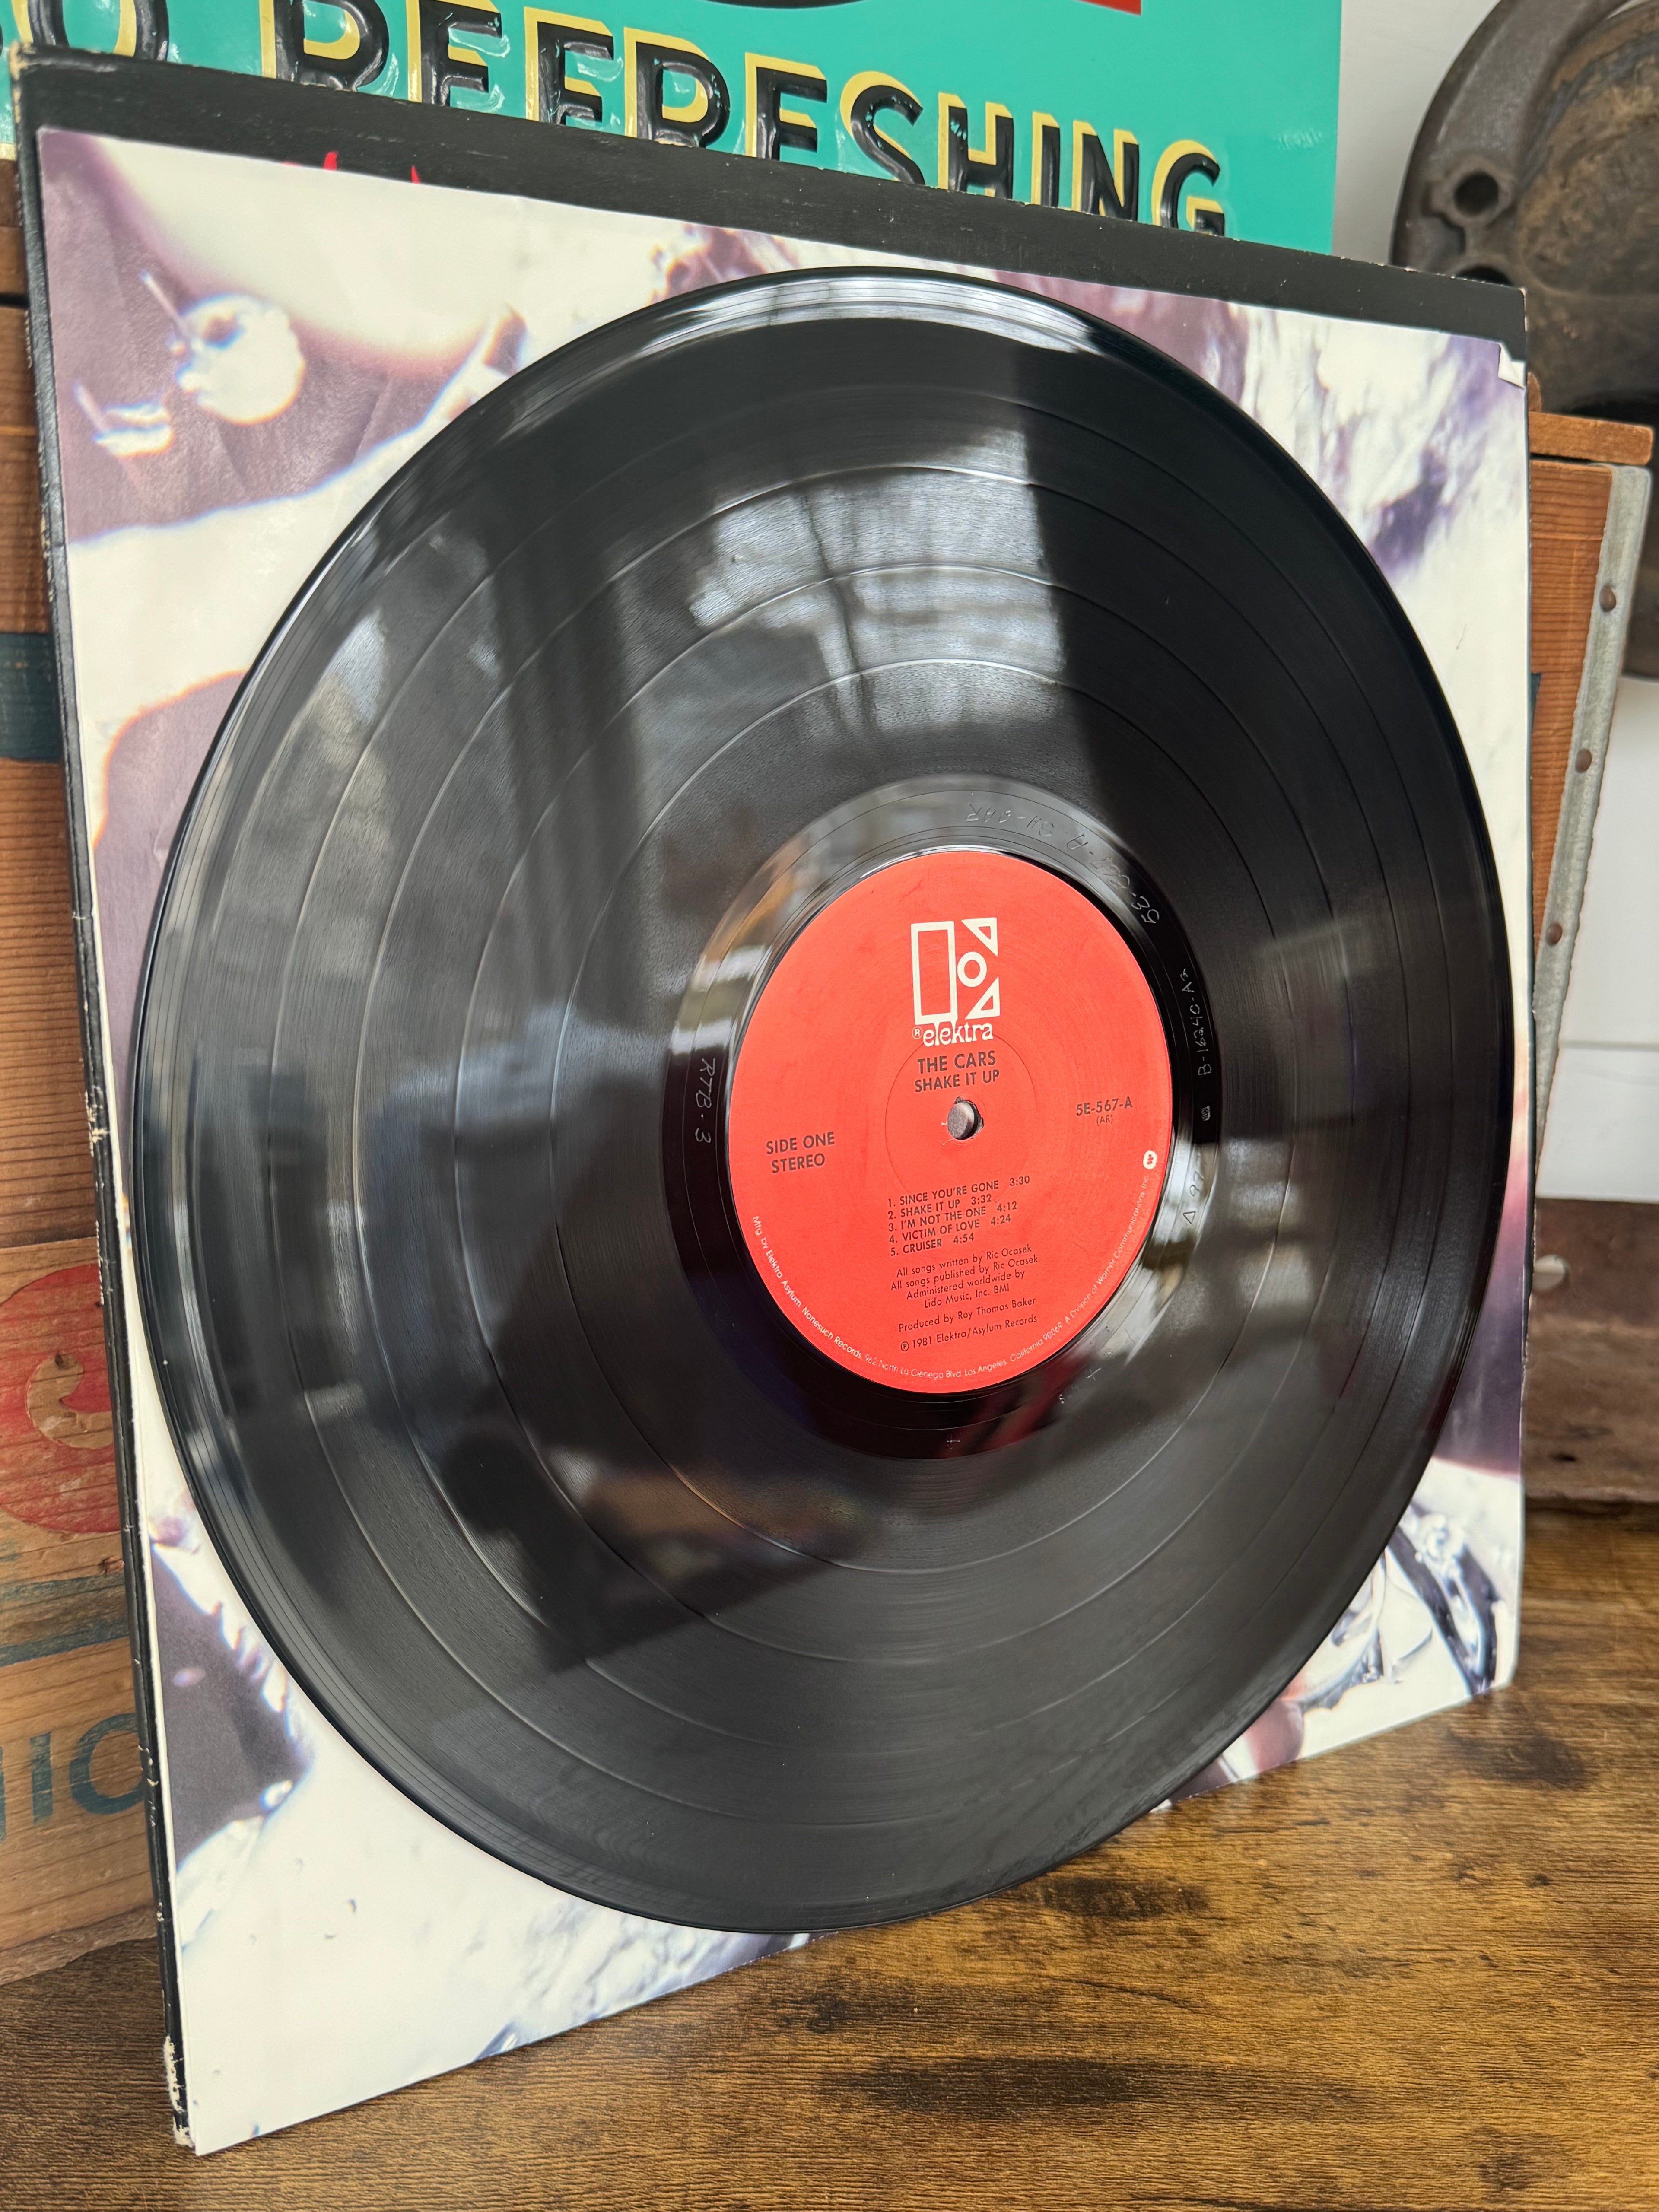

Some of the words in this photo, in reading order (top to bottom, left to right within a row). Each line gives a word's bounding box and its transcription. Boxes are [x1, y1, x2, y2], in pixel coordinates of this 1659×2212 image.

[917, 1055, 947, 1074] THE
[954, 1050, 996, 1069] CARS
[915, 1074, 960, 1092] SHAKE
[966, 1072, 977, 1085] IT
[982, 1069, 999, 1084] UP
[1076, 1096, 1133, 1116] 5E-567-A
[1096, 1114, 1113, 1126] (AR)
[766, 1137, 797, 1154] SIDE
[803, 1131, 835, 1149] ONE
[772, 1153, 825, 1174] STEREO
[888, 1199, 896, 1207] 1.
[900, 1192, 928, 1205] SINCE
[932, 1185, 967, 1199] YOU'RE
[971, 1180, 998, 1192] GONE
[1010, 1175, 1030, 1187] 3:30
[888, 1211, 896, 1220] 2.
[900, 1204, 932, 1217] SHAKE
[936, 1201, 944, 1211] IT
[948, 1199, 960, 1209] UP
[971, 1194, 992, 1205] 3:32
[888, 1223, 896, 1232] 3.
[901, 1219, 915, 1230] I'M
[920, 1214, 941, 1226] NOT
[945, 1210, 962, 1221] THE
[966, 1206, 986, 1218] ONE
[997, 1201, 1017, 1212] 4:12
[889, 1235, 897, 1244] 4.
[902, 1227, 936, 1242] VICTIM
[940, 1224, 952, 1234] OF
[956, 1219, 979, 1232] LOVE
[991, 1214, 1011, 1226] 4:24
[890, 1247, 899, 1256] 5.
[903, 1239, 942, 1254] CRUISER
[953, 1233, 974, 1244] 4:54
[891, 1280, 902, 1291] All
[906, 1277, 930, 1287] songs
[934, 1266, 975, 1285] published
[979, 1264, 989, 1275] by
[993, 1261, 1004, 1271] Ric
[1008, 1254, 1038, 1268] Ocasek
[896, 1267, 907, 1278] All
[912, 1264, 935, 1274] songs
[939, 1257, 969, 1268] written
[973, 1253, 982, 1264] by
[986, 1251, 998, 1260] Ric
[1001, 1243, 1032, 1257] Ocasek
[761, 1237, 768, 1249] by
[802, 1306, 834, 1340] Nonesuch
[900, 1367, 909, 1375] La
[1010, 1339, 1043, 1362] California
[1065, 1316, 1071, 1325] A
[1070, 1294, 1091, 1319] Division
[1092, 1282, 1098, 1294] of
[1096, 1259, 1115, 1285] Warner
[1114, 1191, 1145, 1259] Communications
[906, 1281, 963, 1300] Administered
[967, 1271, 1011, 1287] worldwide
[1015, 1269, 1025, 1279] by
[925, 1299, 942, 1308] Lido
[945, 1294, 972, 1304] Music,
[976, 1288, 990, 1297] Inc.
[994, 1284, 1009, 1294] BMI
[899, 1315, 940, 1332] Produced
[944, 1312, 954, 1324] by
[958, 1310, 973, 1320] Roy
[976, 1304, 1008, 1316] Thomas
[1012, 1297, 1036, 1308] Baker
[912, 1336, 932, 1348] 1981
[937, 1322, 1001, 1343] Elektra/Asylum
[1005, 1314, 1037, 1328] Records
